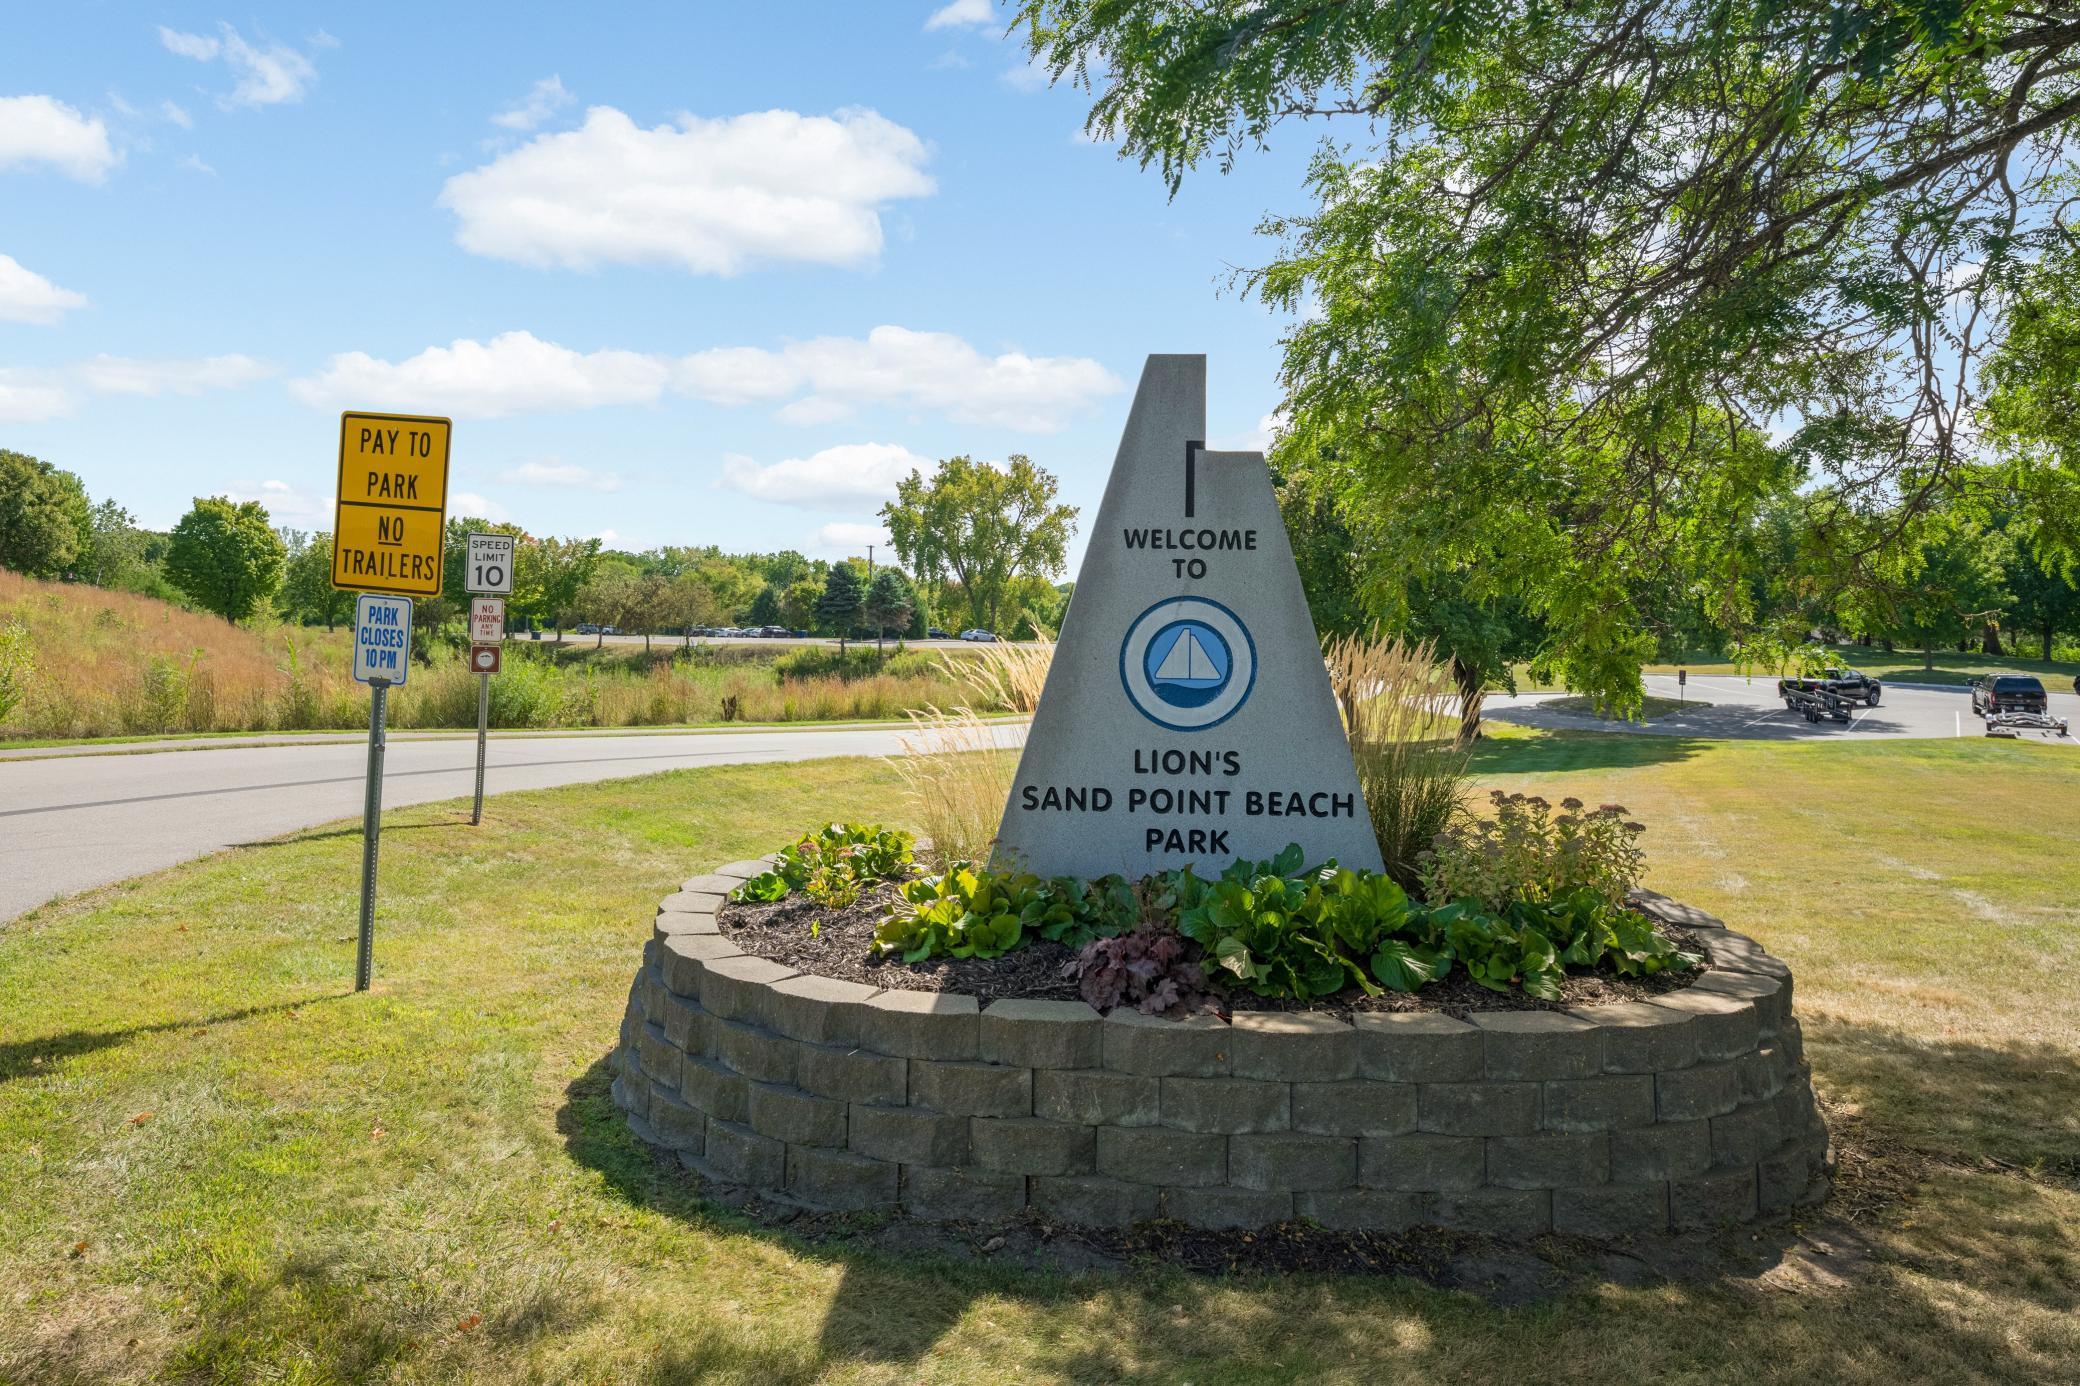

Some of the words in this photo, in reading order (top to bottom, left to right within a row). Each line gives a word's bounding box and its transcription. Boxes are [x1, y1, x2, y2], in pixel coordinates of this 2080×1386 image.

[360, 428, 399, 455] PAY
[409, 431, 431, 458] TO
[367, 471, 418, 500] PARK
[378, 515, 404, 542] NO
[1123, 528, 1257, 550] WELCOME
[472, 540, 510, 550] SPEED
[342, 549, 434, 581] TRAILERS
[475, 553, 505, 562] LIMIT
[475, 565, 504, 587] 10
[1172, 558, 1207, 580] TO
[368, 605, 399, 626] PARK
[474, 614, 501, 624] PARKING
[482, 604, 494, 614] NO
[361, 626, 404, 648] CLOSES
[480, 629, 495, 637] TIME
[366, 648, 378, 668] 10
[379, 650, 397, 670] PM
[1134, 749, 1241, 777] LION'S
[1022, 785, 1113, 812] SAND
[1128, 788, 1231, 816] POINT
[1245, 791, 1355, 818] BEACH
[1145, 828, 1231, 855] PARK
